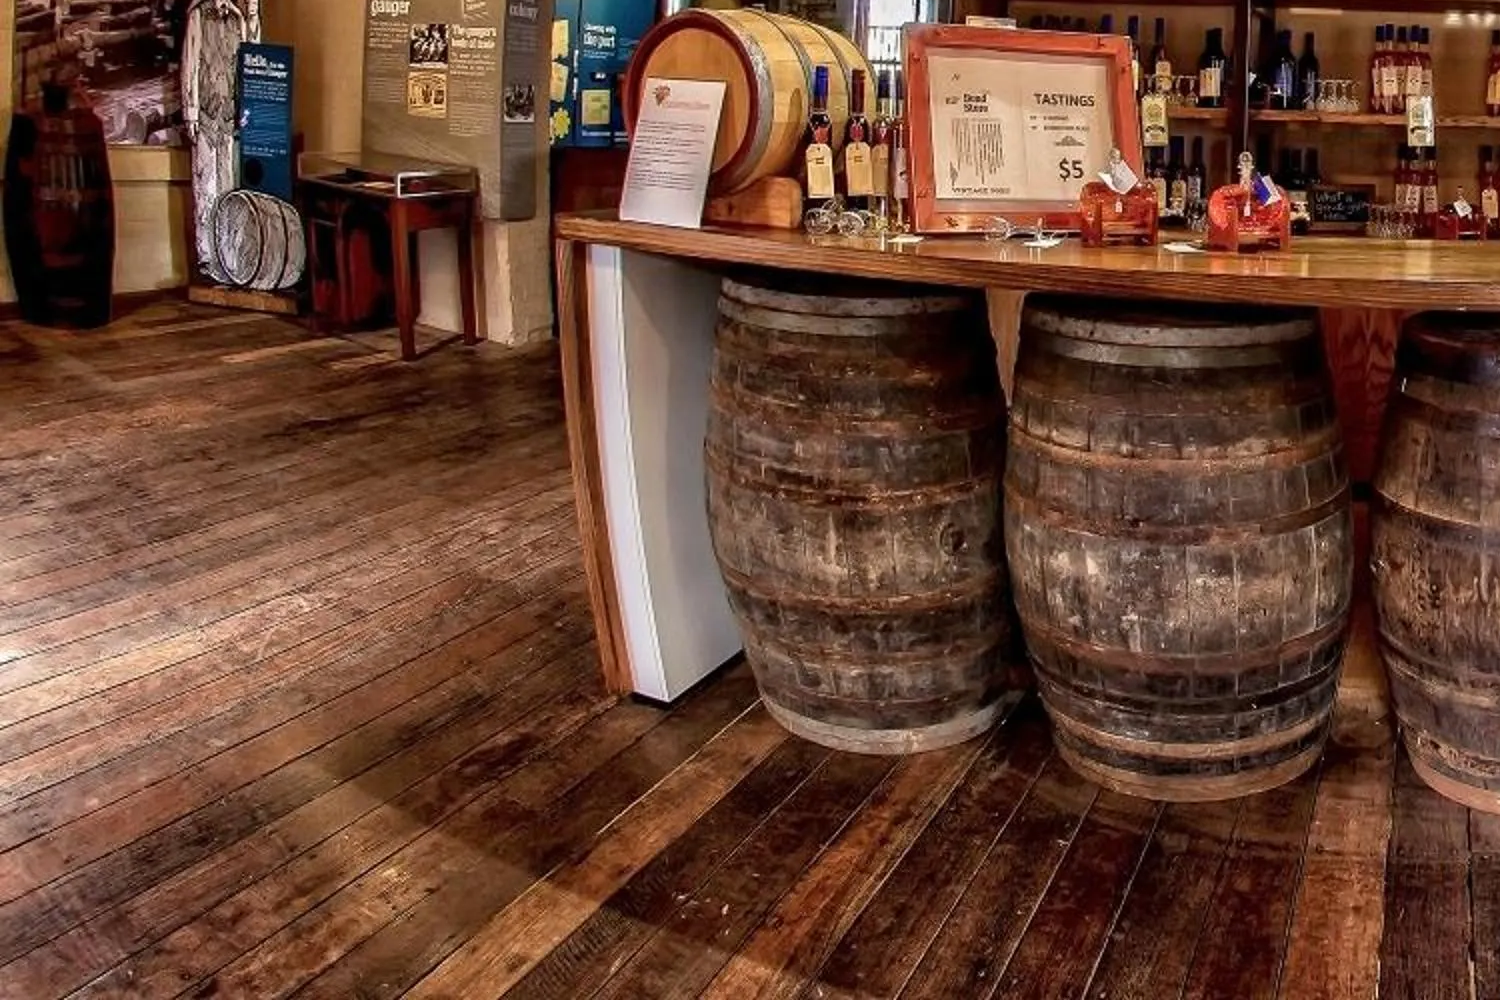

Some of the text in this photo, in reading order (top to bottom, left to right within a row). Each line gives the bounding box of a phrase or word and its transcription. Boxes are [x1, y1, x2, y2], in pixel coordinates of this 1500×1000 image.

[371, 0, 411, 17] gauger
[1033, 93, 1095, 107] TASTINGS
[1059, 157, 1085, 182] $5
